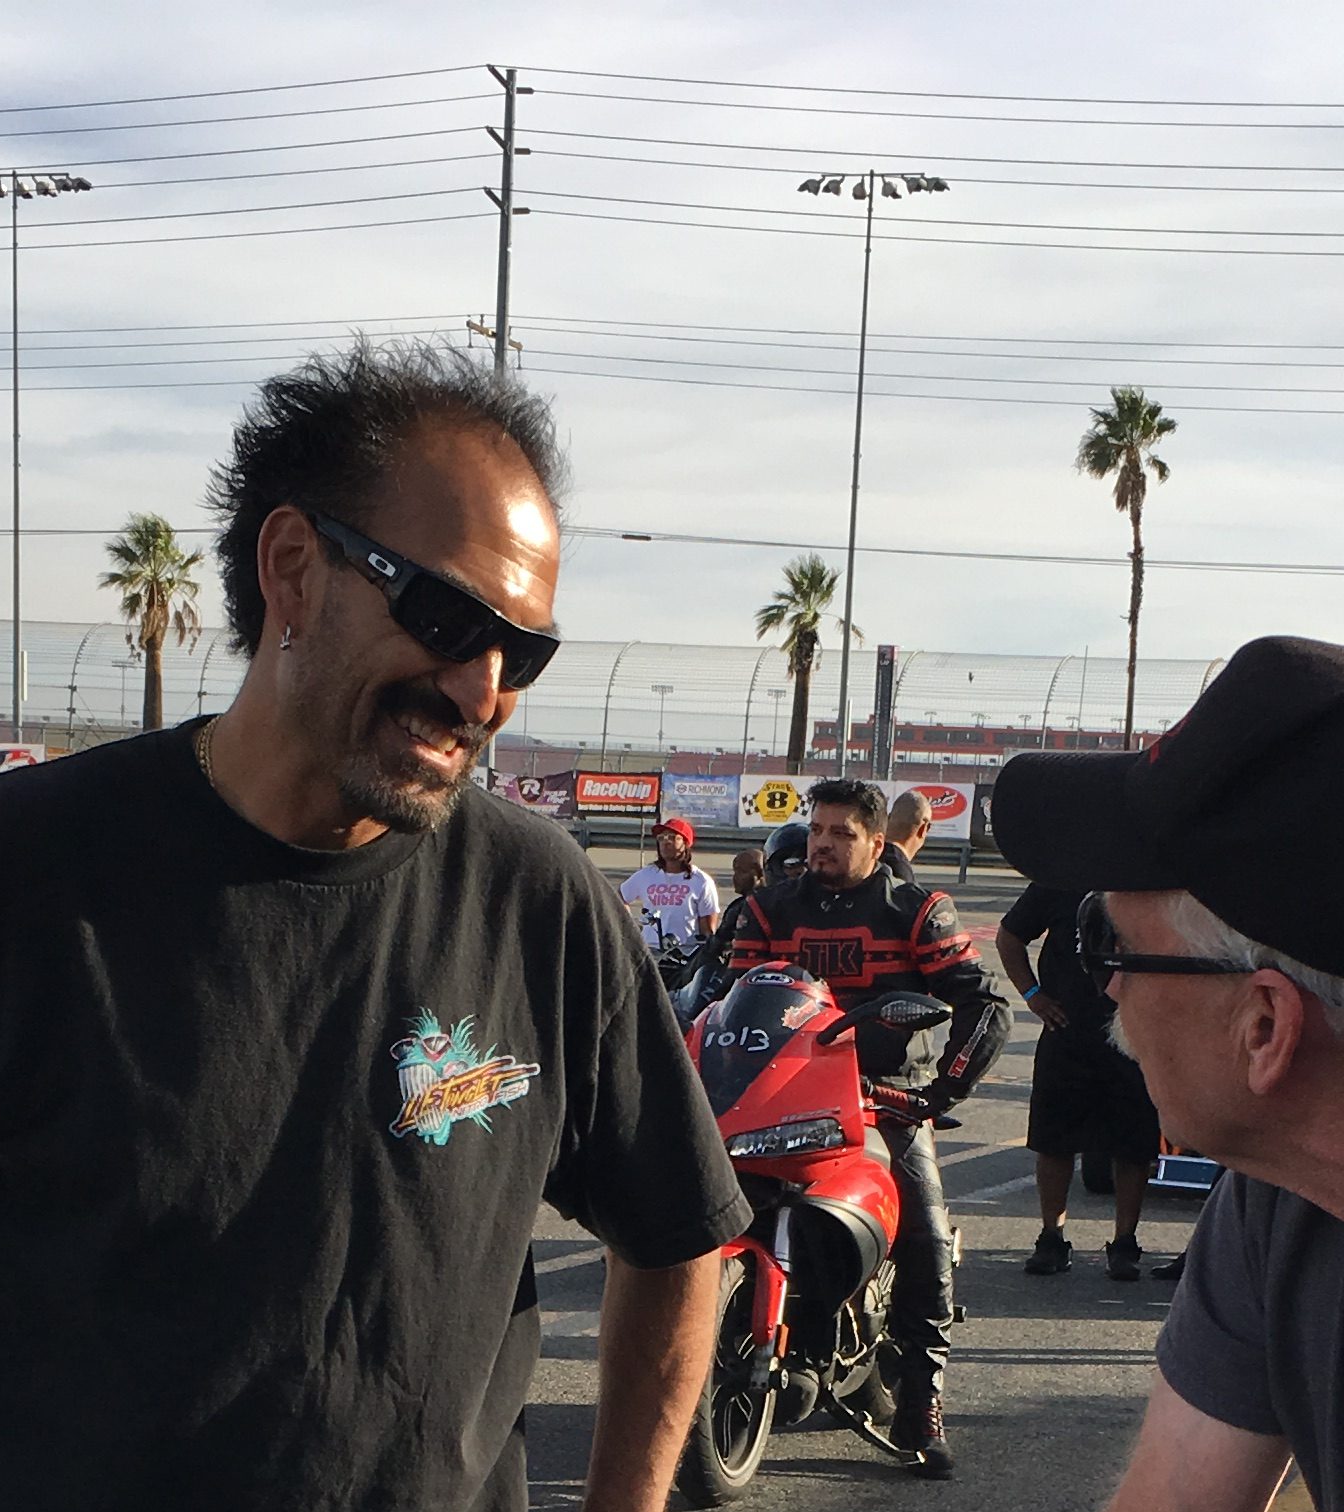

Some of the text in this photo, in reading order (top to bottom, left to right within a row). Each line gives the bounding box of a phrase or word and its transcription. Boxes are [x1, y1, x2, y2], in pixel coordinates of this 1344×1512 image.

[582, 779, 652, 800] RaceQuip
[647, 884, 691, 895] GOOD
[704, 1028, 770, 1051] 1013
